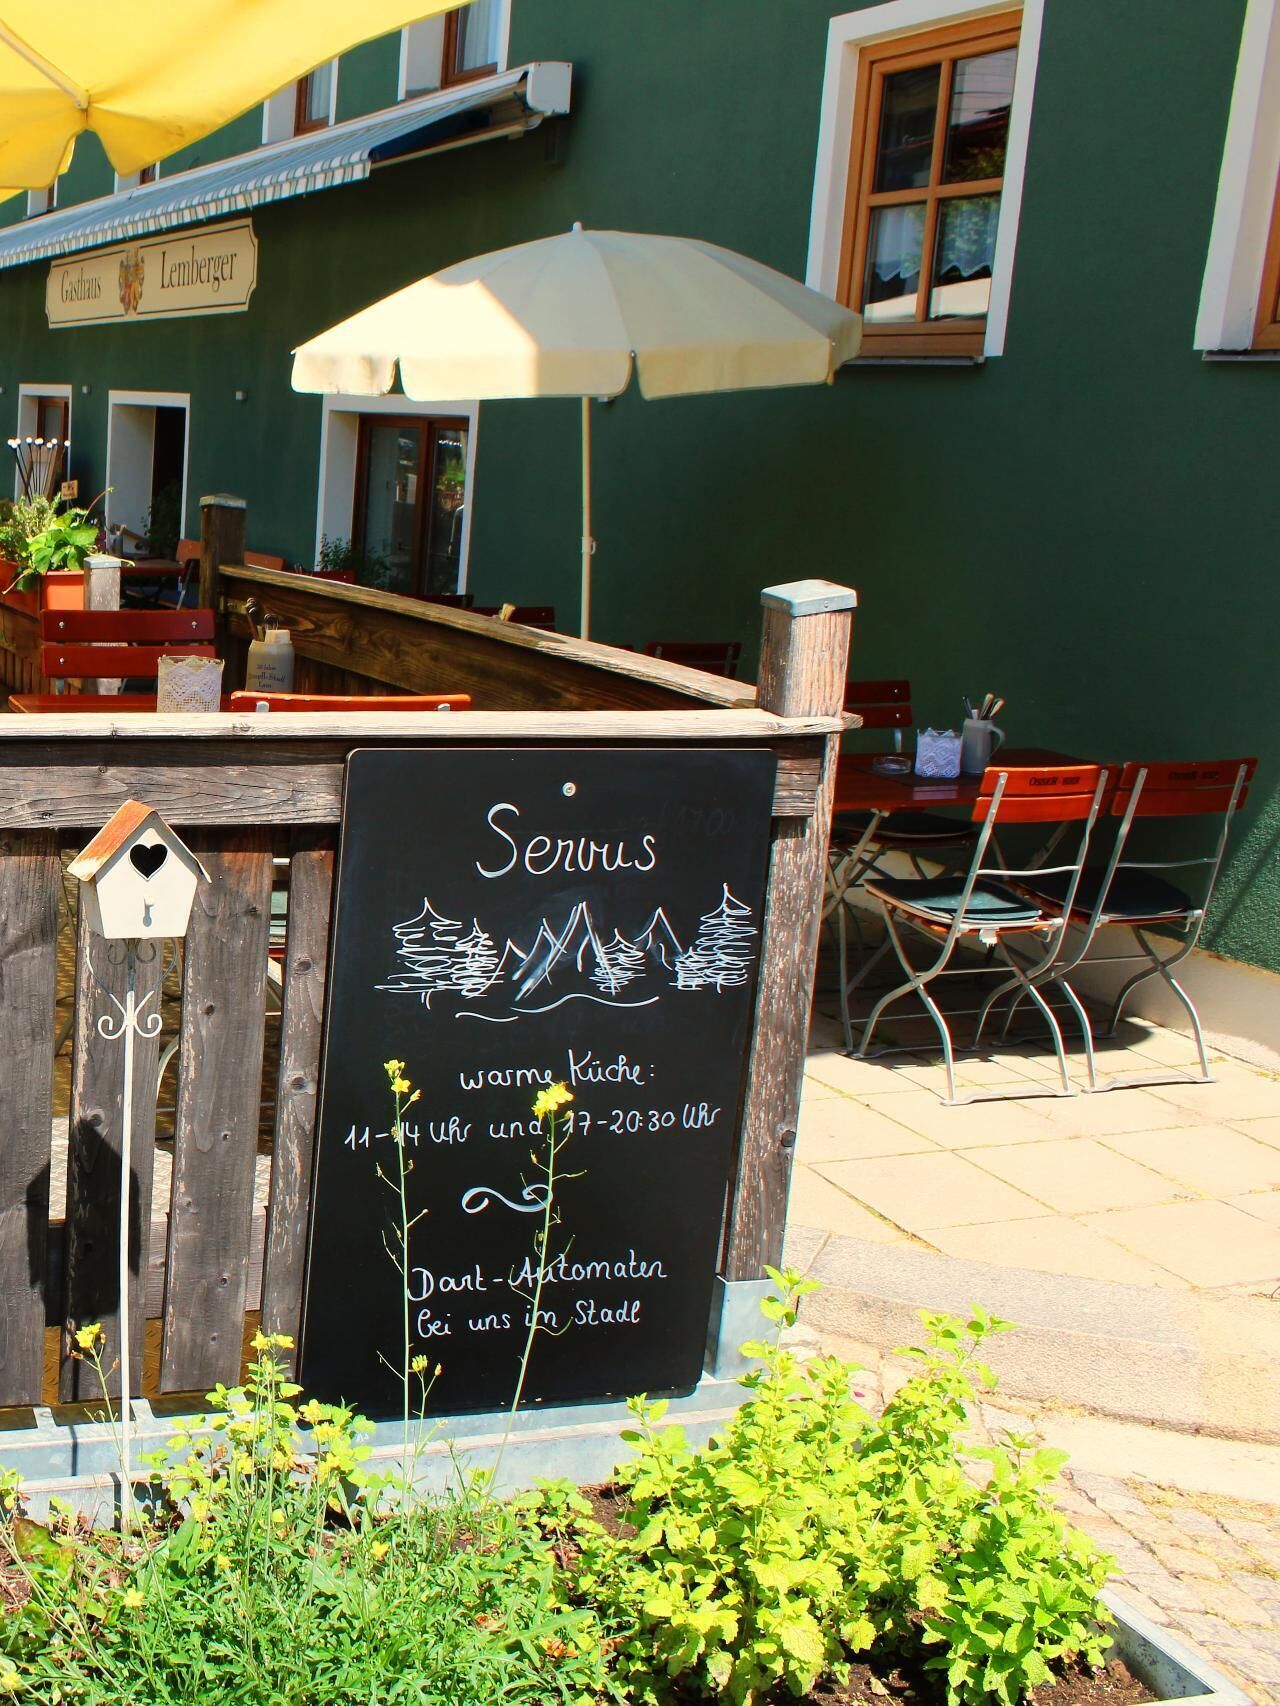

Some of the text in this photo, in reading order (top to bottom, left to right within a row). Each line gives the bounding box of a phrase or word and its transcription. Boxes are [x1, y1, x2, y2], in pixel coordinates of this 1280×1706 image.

[60, 245, 238, 304] Gasthaus Lemberger
[475, 801, 657, 879] Servus
[459, 1048, 656, 1090] warme Küche:
[344, 1102, 721, 1151] 11-14 Uhr und 17-20:30 Uhr
[407, 1249, 668, 1302] Dart-Automaten
[417, 1299, 641, 1338] bei uns im Stadl
